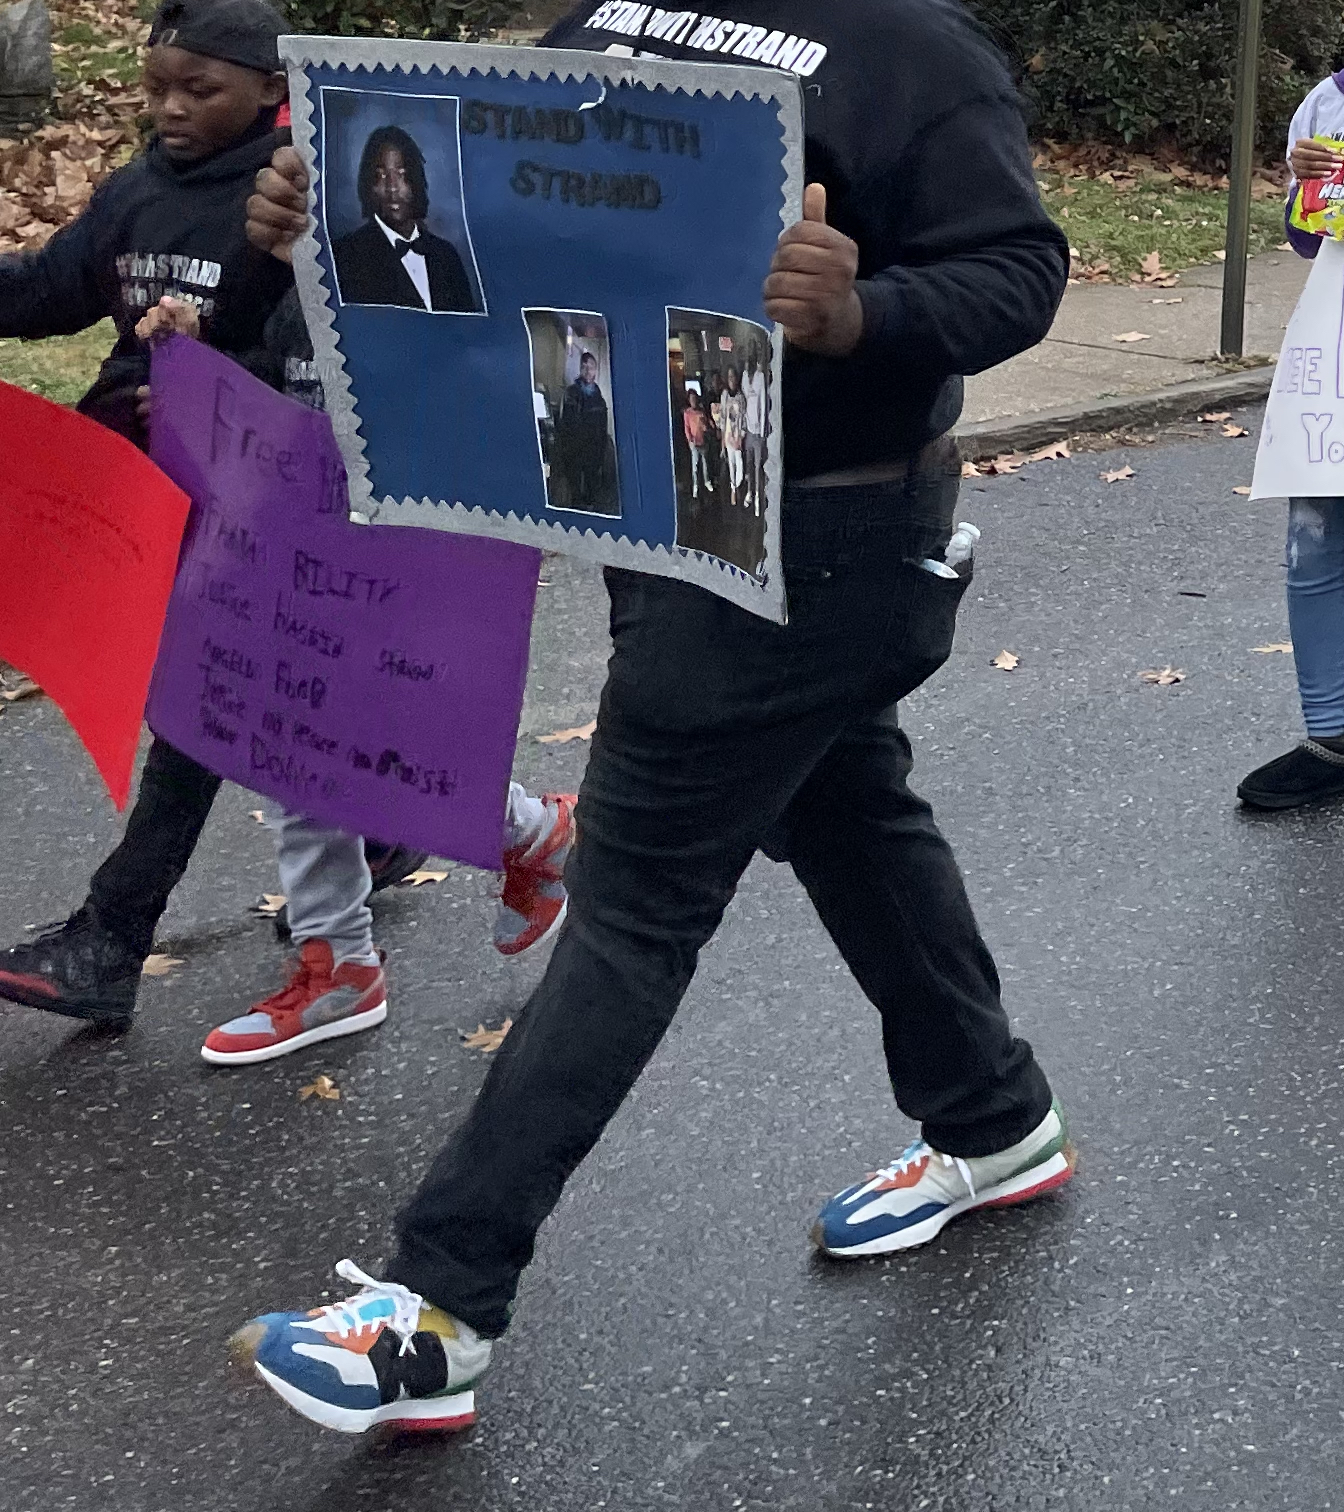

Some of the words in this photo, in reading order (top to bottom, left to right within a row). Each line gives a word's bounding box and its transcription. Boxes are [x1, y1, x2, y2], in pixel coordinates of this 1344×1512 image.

[462, 99, 585, 145] STAND
[591, 102, 701, 159] WITH
[510, 159, 662, 211] STRAND
